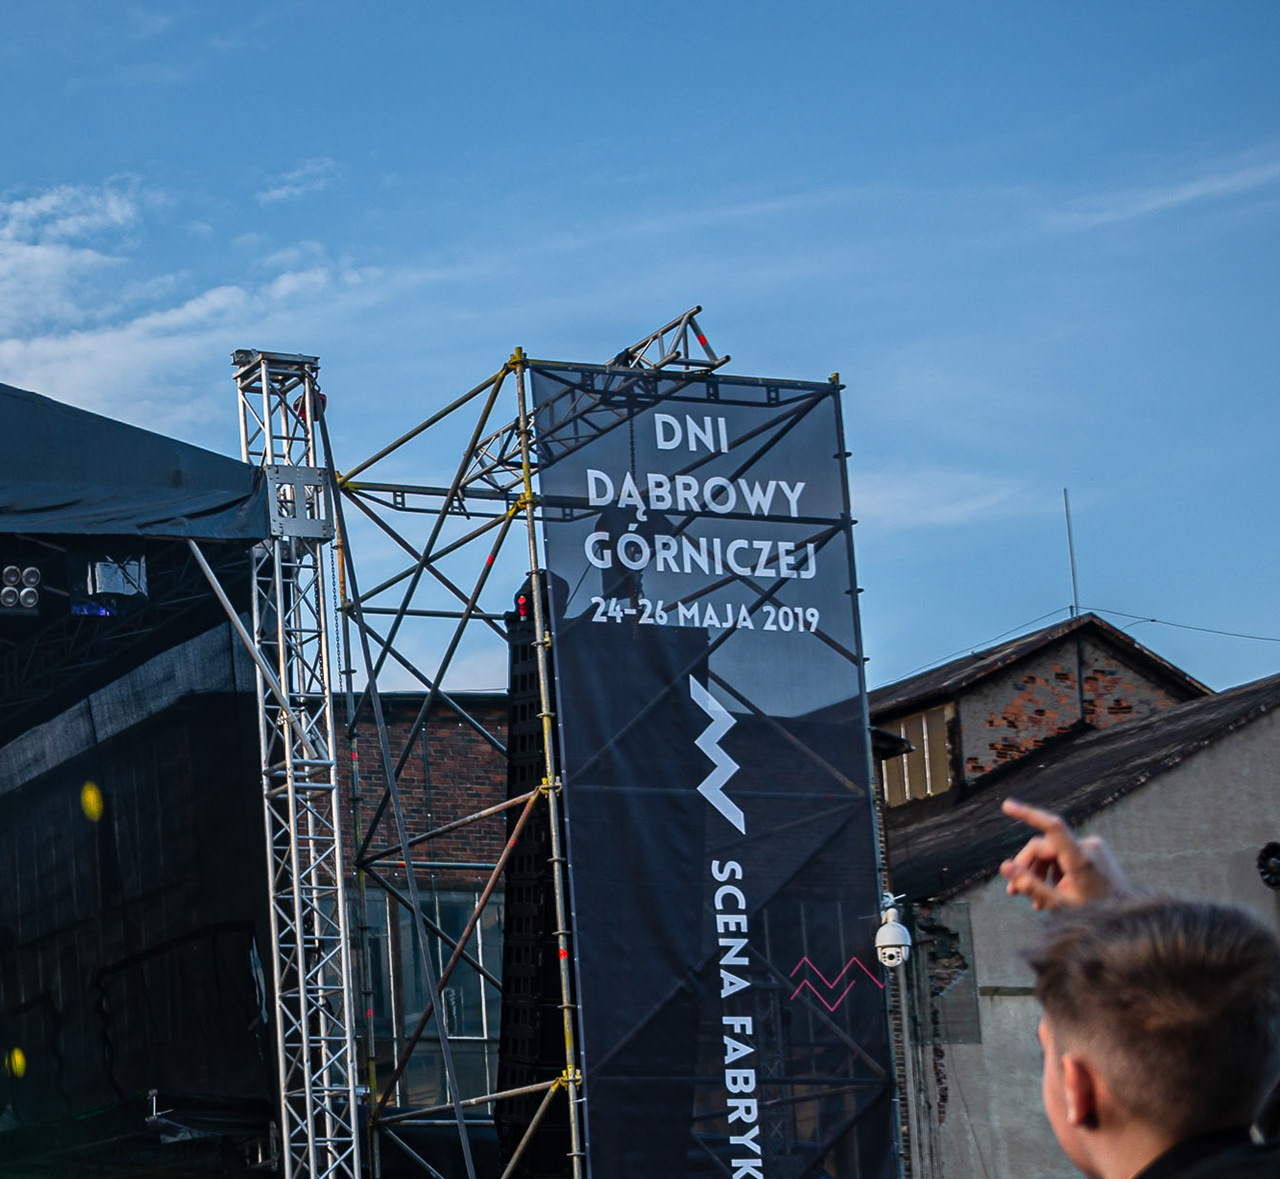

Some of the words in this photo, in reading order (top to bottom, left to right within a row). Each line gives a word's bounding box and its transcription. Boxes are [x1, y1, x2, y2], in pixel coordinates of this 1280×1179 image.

[654, 413, 729, 454] DNI
[586, 468, 806, 521] DĄBROWY
[584, 522, 818, 580] GÓRNICZEJ
[678, 600, 754, 631] MAJA
[763, 604, 820, 634] 2019
[710, 859, 752, 999] SCENA
